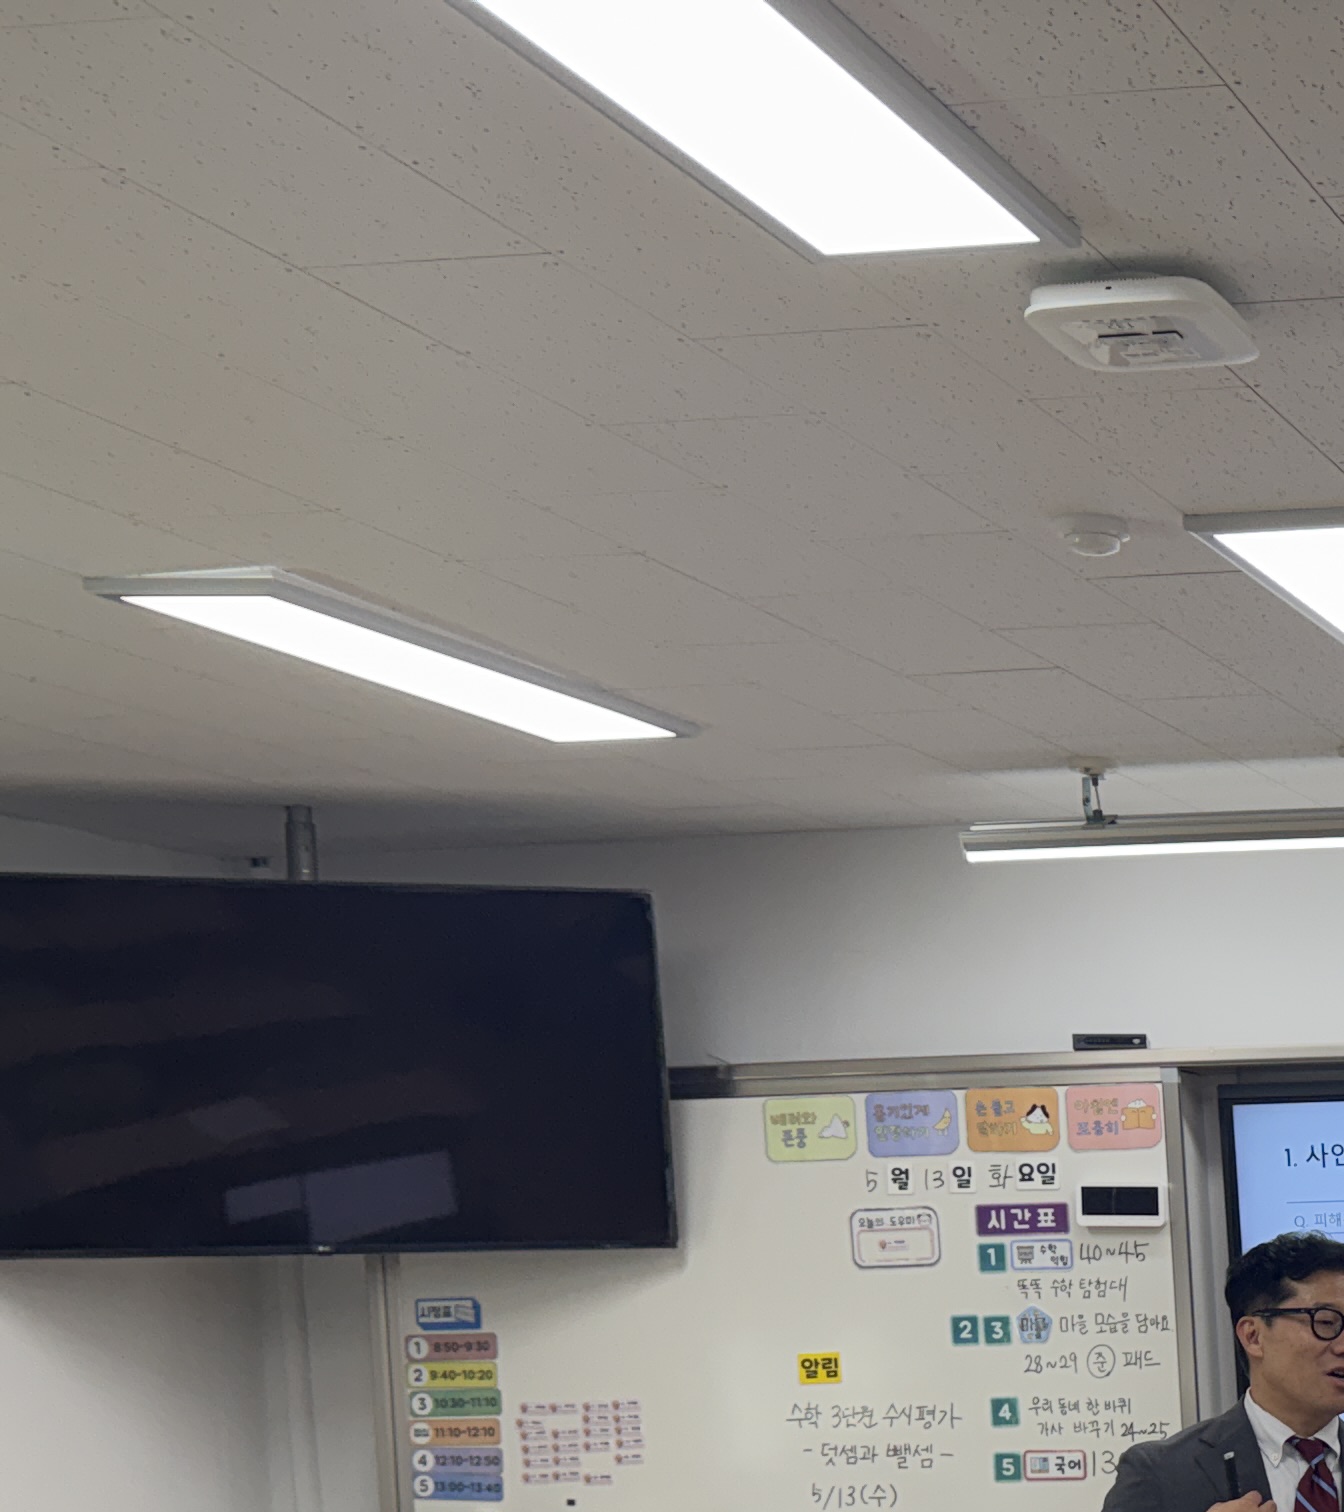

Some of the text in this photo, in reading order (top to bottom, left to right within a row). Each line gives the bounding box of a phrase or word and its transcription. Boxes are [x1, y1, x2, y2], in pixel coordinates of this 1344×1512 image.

[991, 1099, 1016, 1117] 들고
[1285, 1148, 1297, 1167] 1.
[866, 1163, 1056, 1193] 5 월 13 일 화 요일
[858, 1216, 915, 1229] 오늘의 도우미
[987, 1208, 1056, 1230] 시간표
[1294, 1215, 1309, 1228] Q.
[986, 1247, 997, 1267] 1
[1040, 1243, 1058, 1255] 수학
[1080, 1240, 1149, 1264] 40~45
[1017, 1276, 1128, 1302] 똑똑 수학 탐험대
[959, 1320, 972, 1339] 2
[991, 1321, 1004, 1340] 3
[1059, 1314, 1089, 1335] 마을
[1094, 1312, 1130, 1334] 모습을
[414, 1342, 421, 1355] 1
[800, 1357, 839, 1379] 알림
[1023, 1352, 1078, 1374] 28~29
[1122, 1350, 1161, 1367] 패드
[413, 1369, 423, 1382] 2
[418, 1398, 427, 1411] 3
[998, 1403, 1012, 1421] 4
[1028, 1396, 1131, 1416] 우리 동네 한 바퀴
[785, 1402, 963, 1430] 수학 3단원 수시평가
[1037, 1421, 1170, 1442] 가사 바꾸기 24~25
[418, 1455, 427, 1466] 4
[820, 1443, 933, 1469] 덧셈과 뺄셈
[1054, 1456, 1081, 1475] 국어
[1002, 1458, 1015, 1476] 5
[419, 1480, 428, 1492] 5
